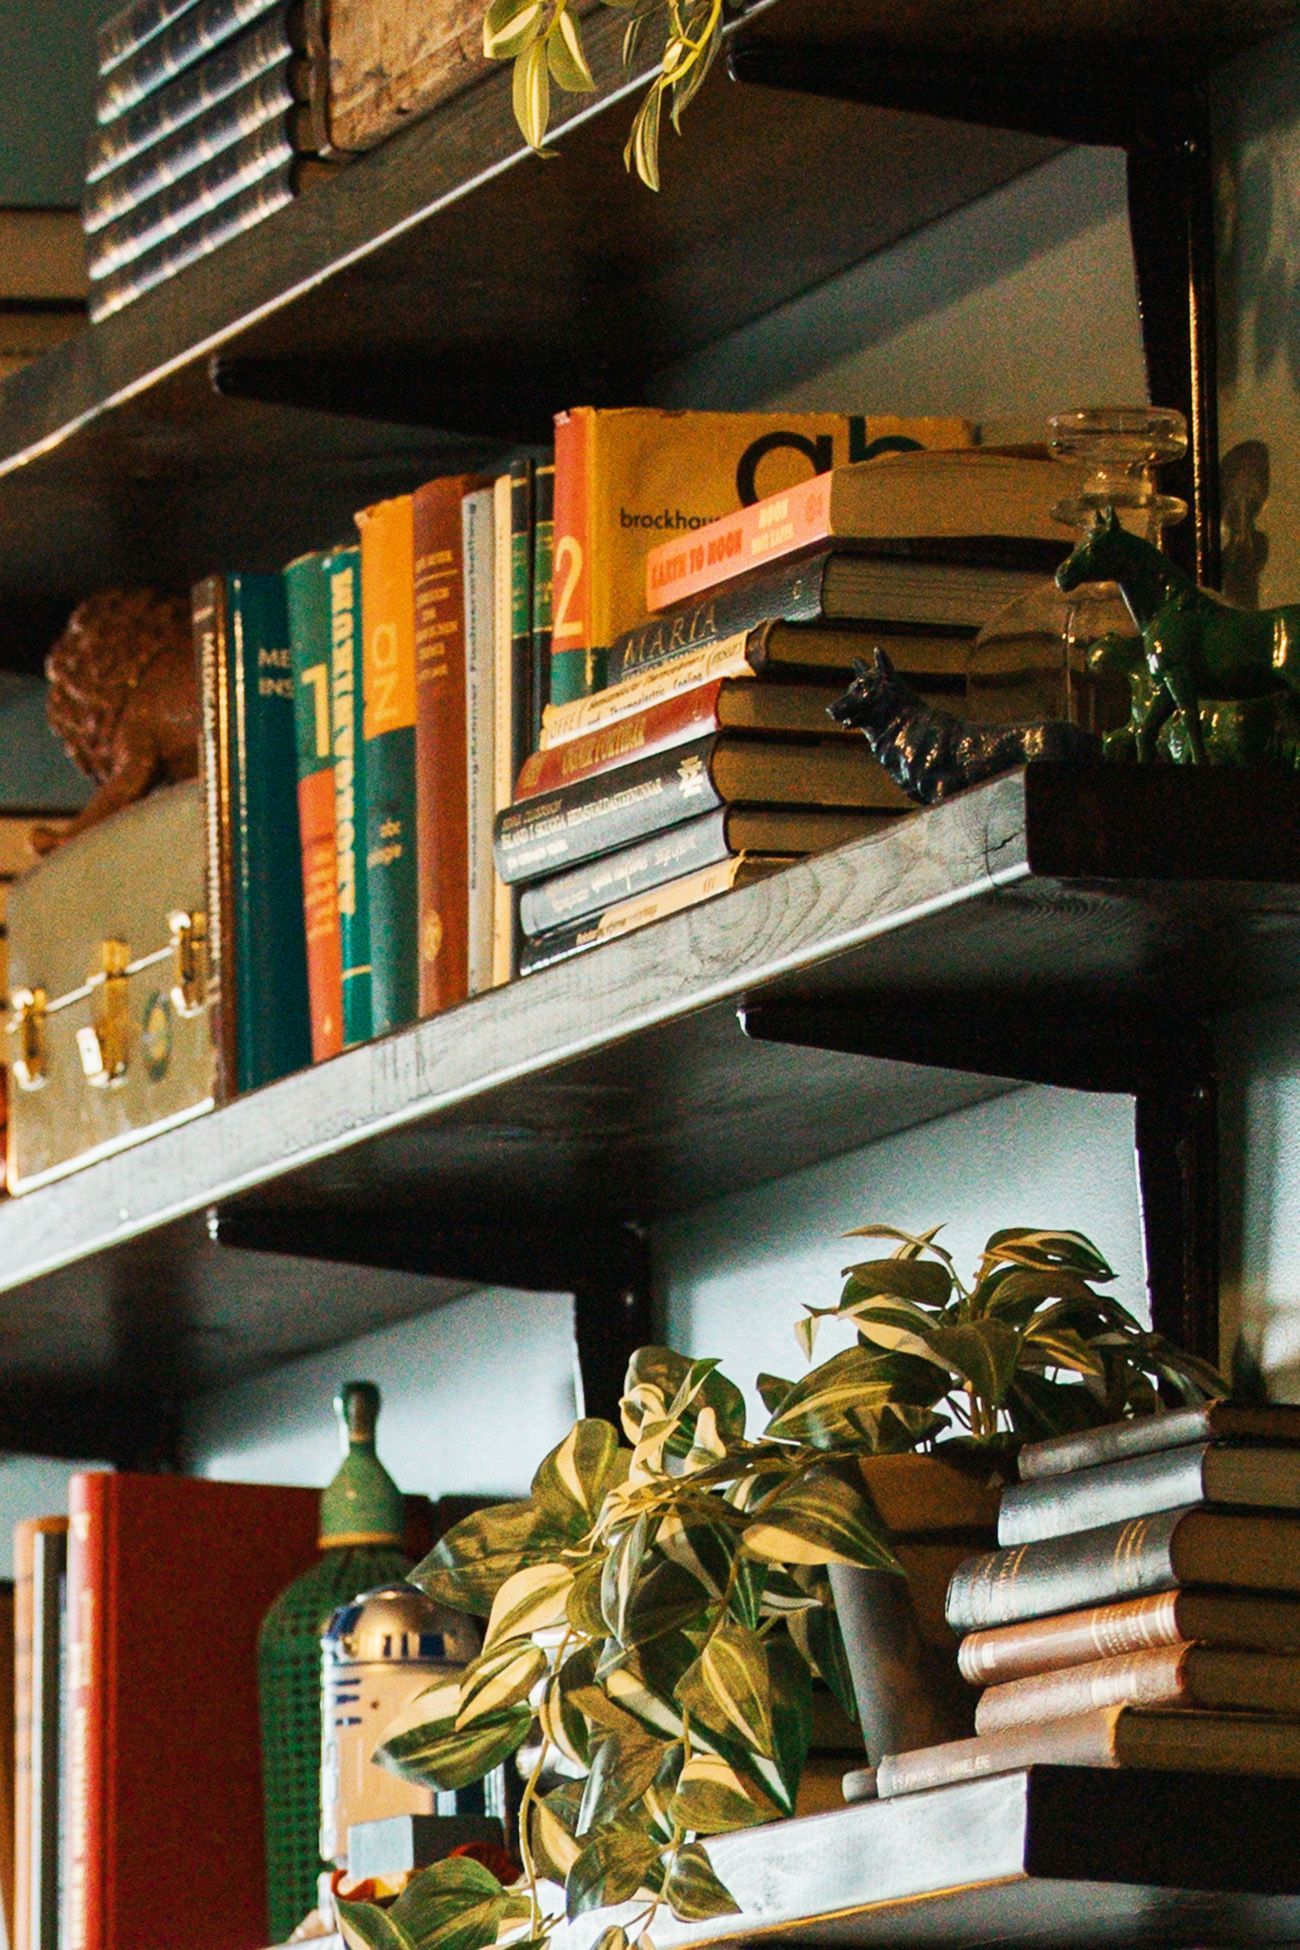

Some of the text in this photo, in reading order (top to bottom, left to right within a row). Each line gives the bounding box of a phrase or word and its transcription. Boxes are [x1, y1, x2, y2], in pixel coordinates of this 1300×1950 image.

[553, 535, 583, 638] 2
[258, 648, 291, 668] ME
[301, 663, 329, 758] 1
